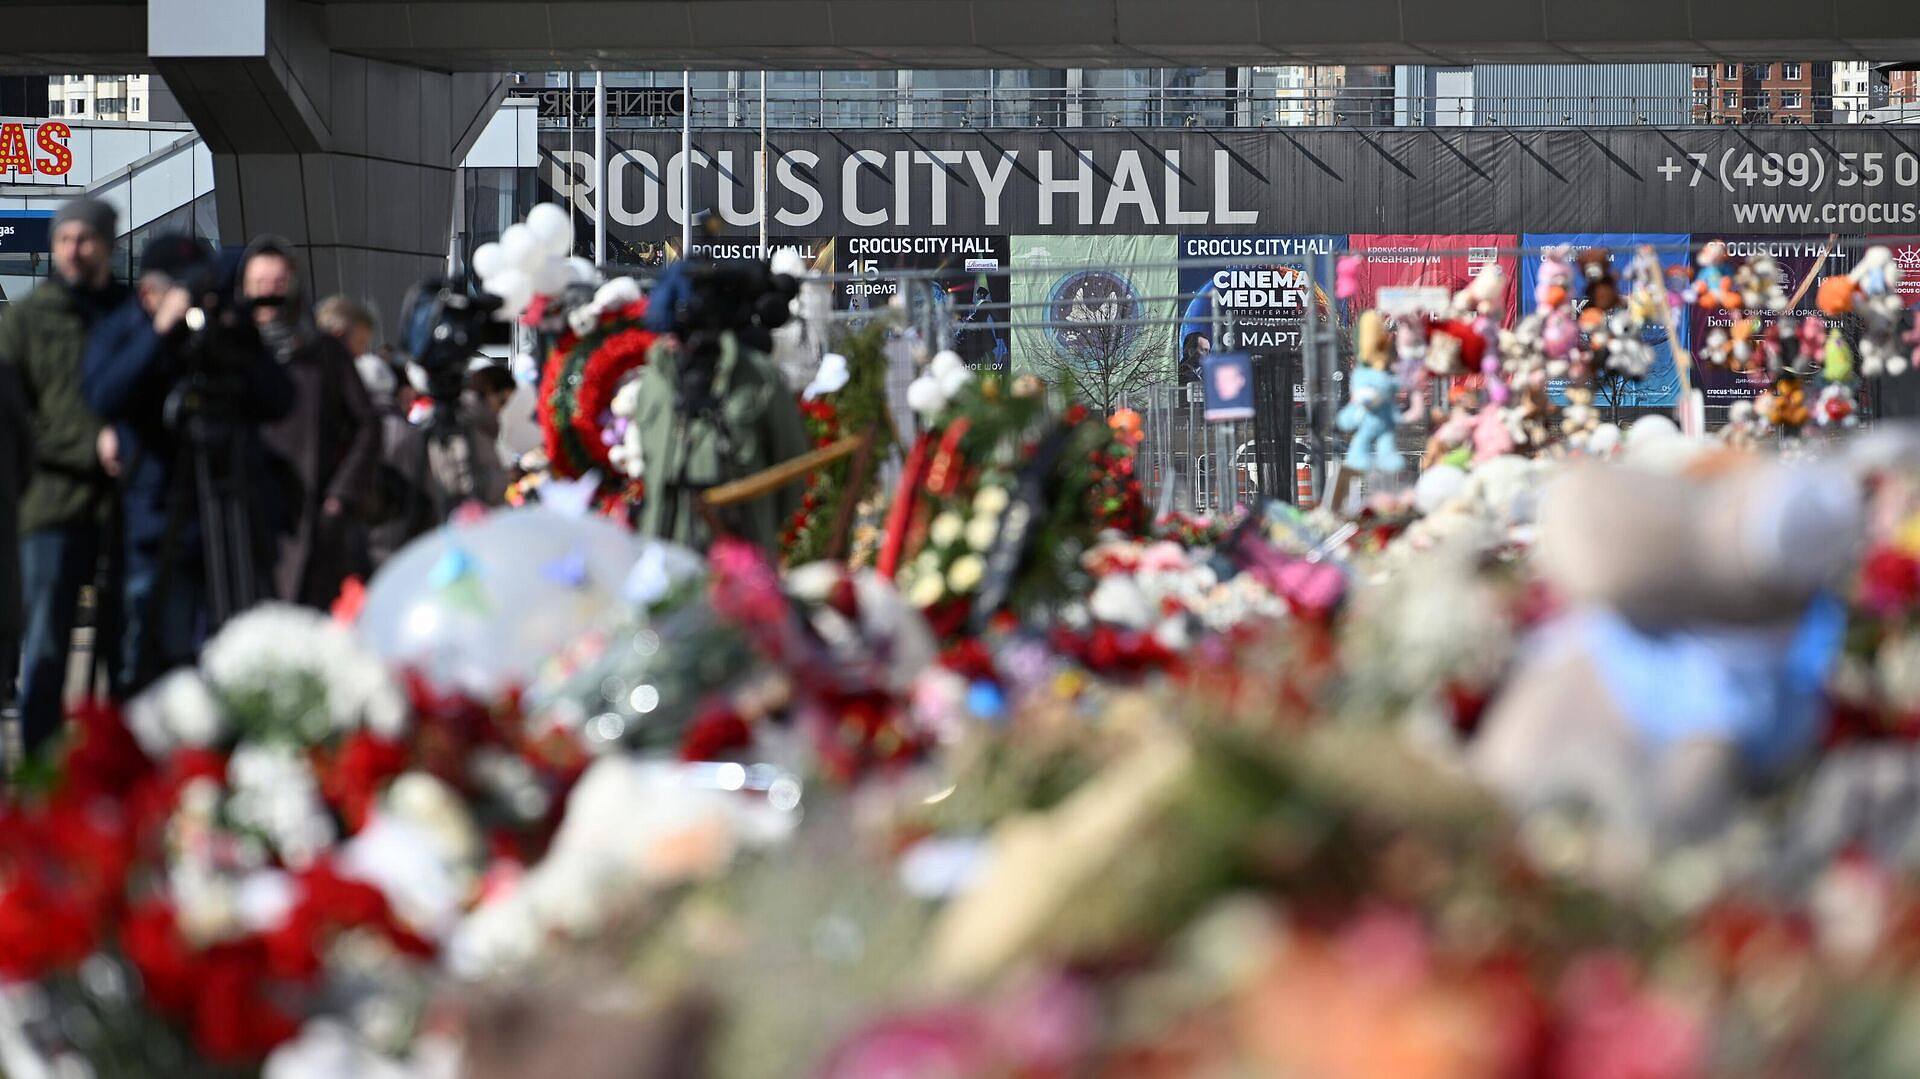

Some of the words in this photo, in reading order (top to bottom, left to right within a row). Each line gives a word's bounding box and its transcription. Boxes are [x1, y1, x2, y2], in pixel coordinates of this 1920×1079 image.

[1719, 147, 1825, 193] (499)
[538, 150, 824, 227] ROCUS
[842, 150, 1017, 227] CITY
[1039, 150, 1260, 225] HALL
[850, 238, 912, 254] CROCUS
[914, 238, 949, 253] CITY
[952, 238, 995, 253] HALL
[1187, 239, 1252, 255] CROCUS
[1255, 239, 1291, 255] CITY
[1769, 242, 1801, 257] CITY
[1367, 256, 1441, 266] океанариум
[848, 259, 879, 281] 15
[1213, 270, 1310, 288] CINEMA
[845, 284, 897, 297] апреля
[1212, 290, 1311, 307] MEDLEY
